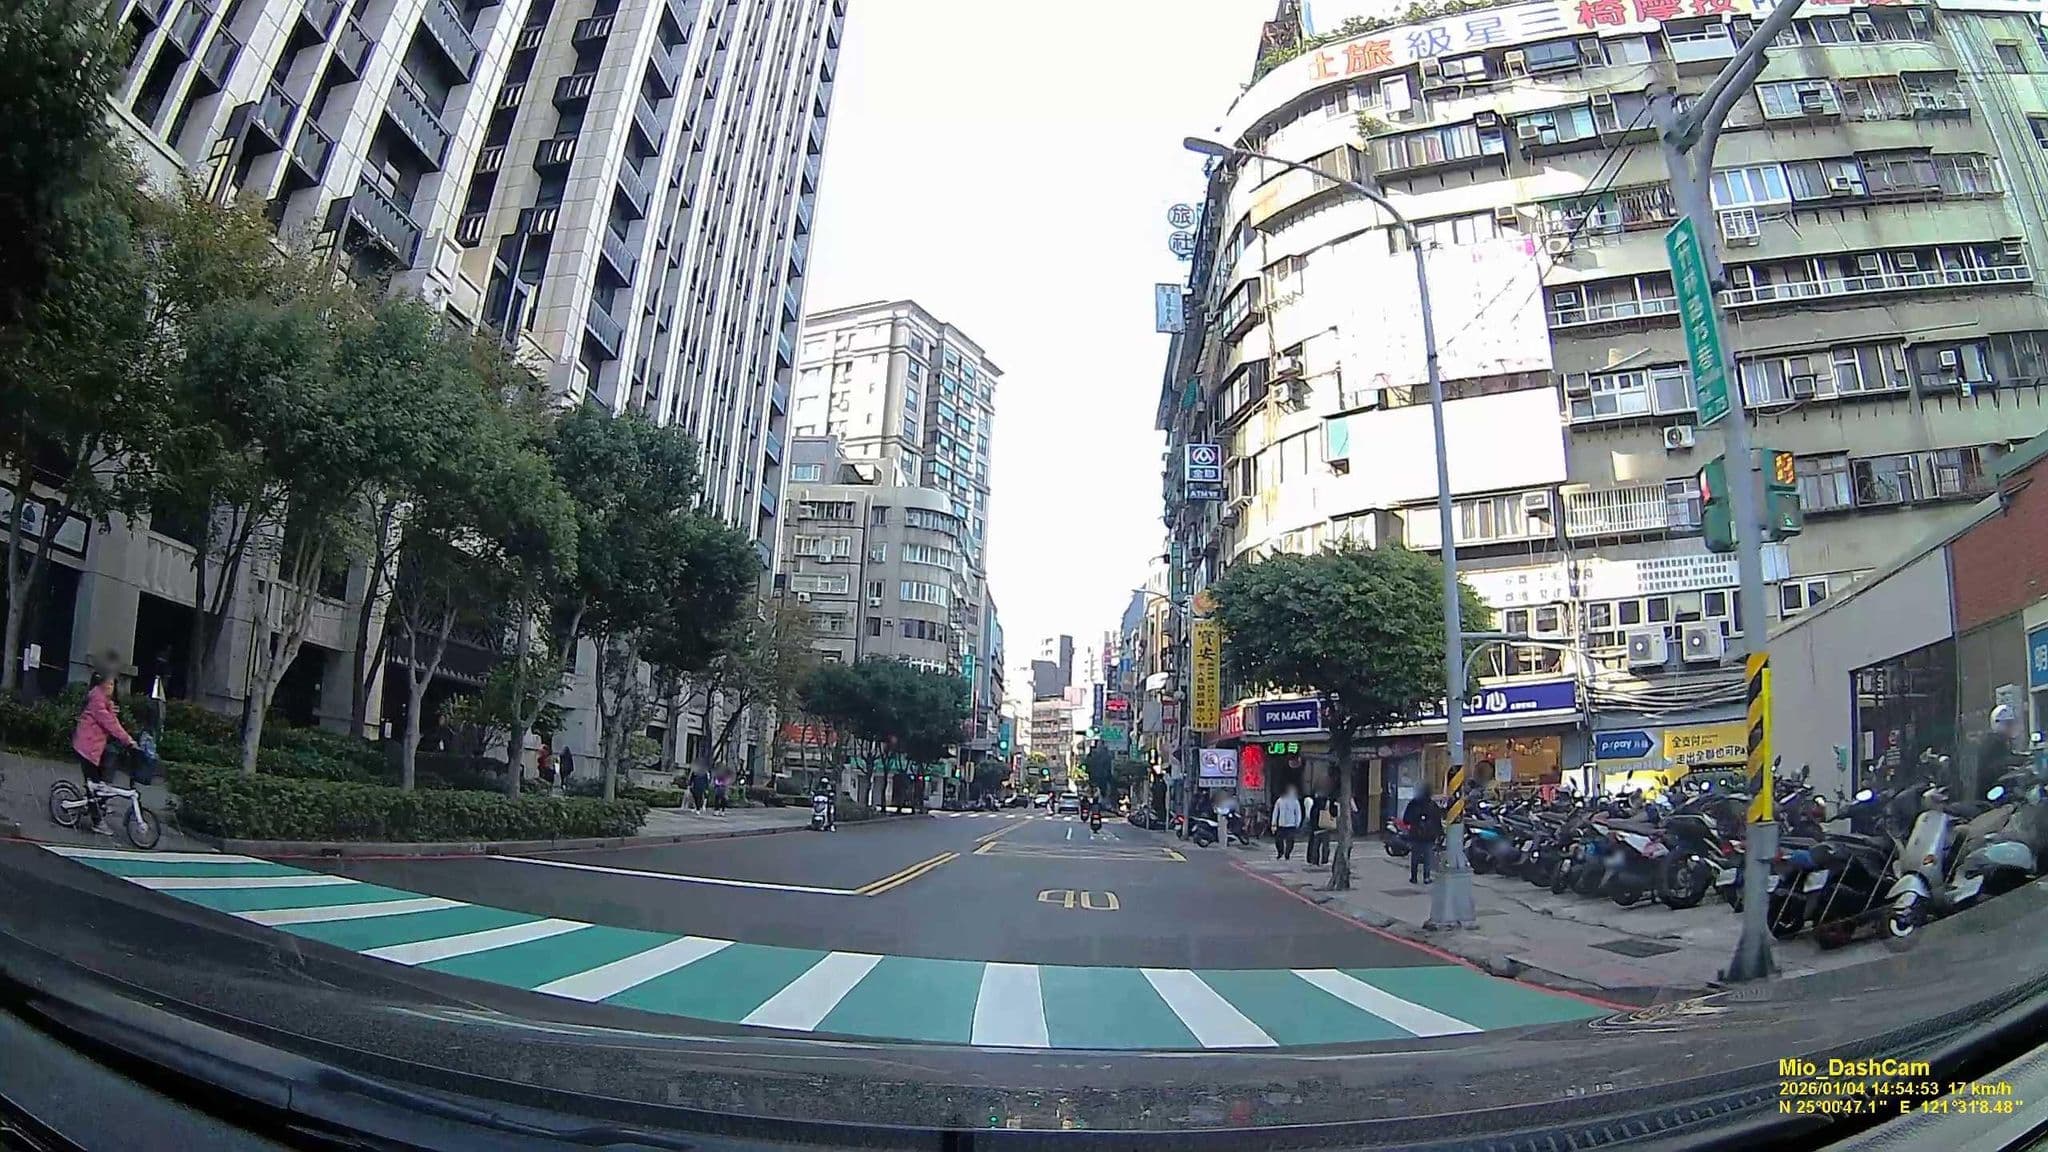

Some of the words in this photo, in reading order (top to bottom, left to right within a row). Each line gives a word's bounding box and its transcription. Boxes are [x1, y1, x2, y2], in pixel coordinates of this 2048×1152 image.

[1266, 711, 1280, 722] PX
[1281, 710, 1311, 722] MART
[1671, 734, 1700, 748] 全支付
[1038, 890, 1119, 910] 40
